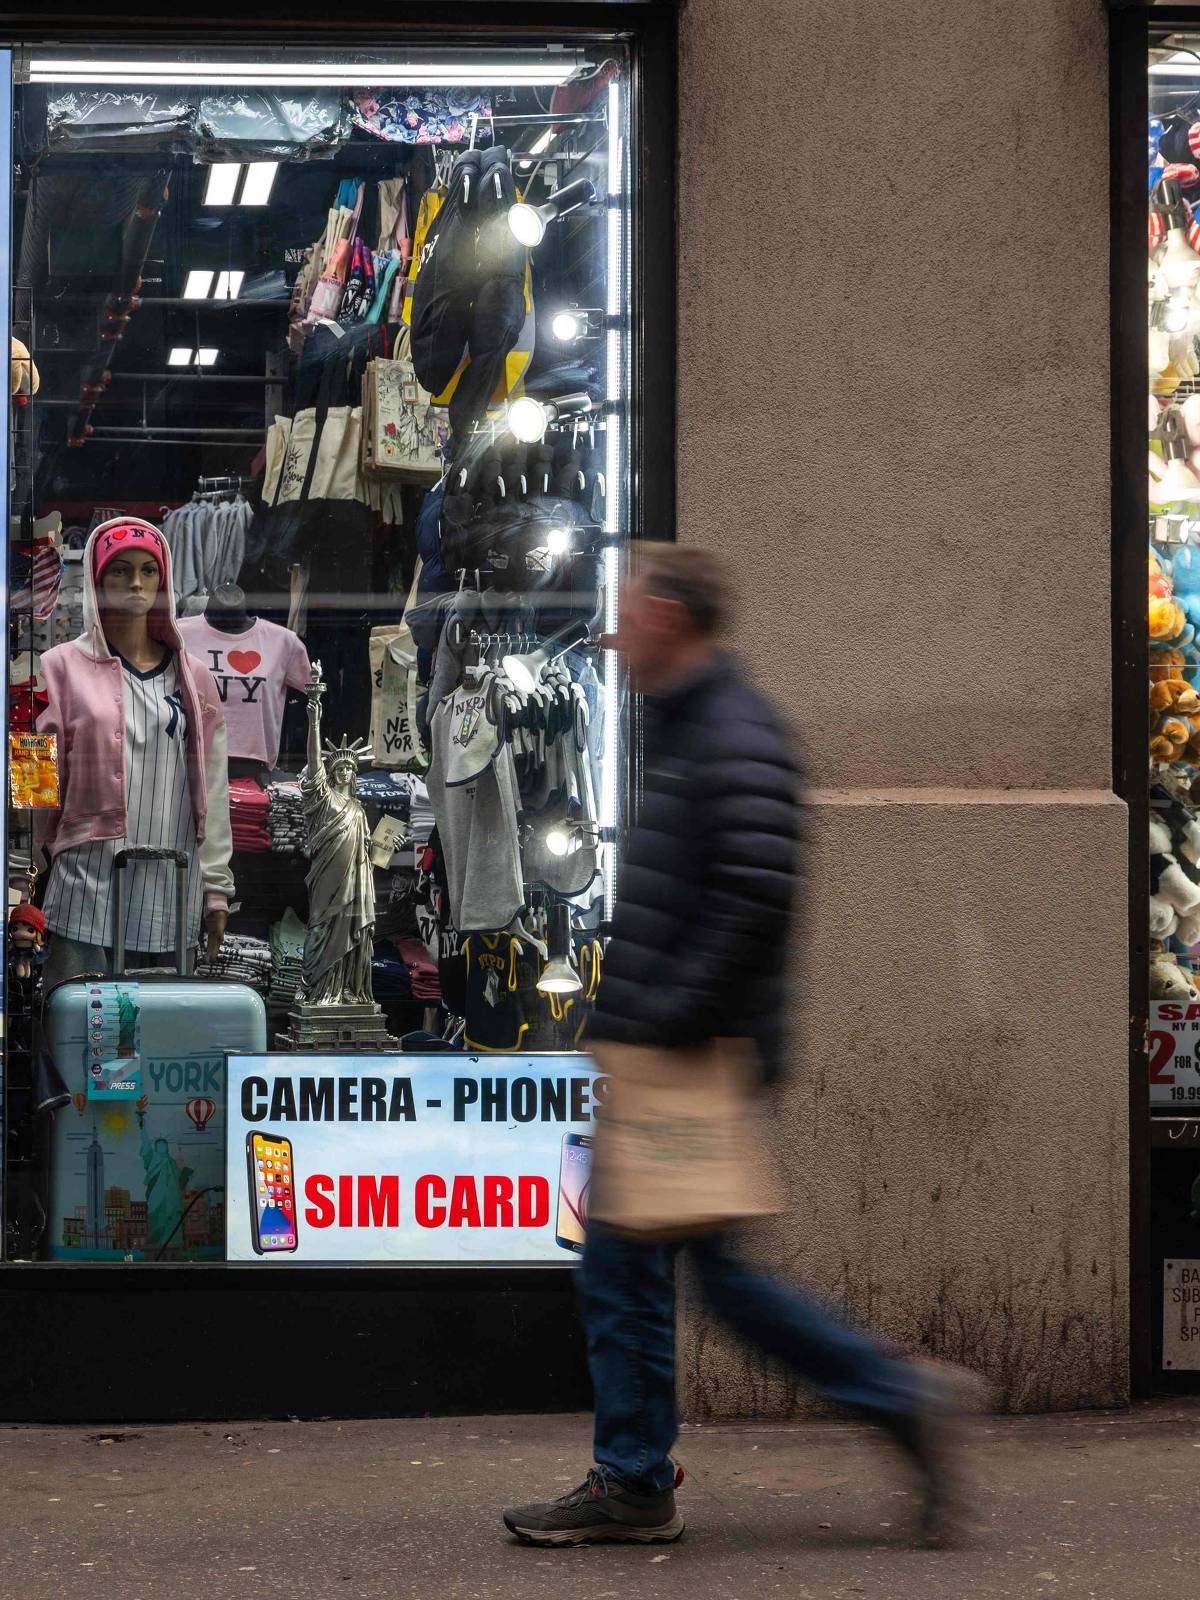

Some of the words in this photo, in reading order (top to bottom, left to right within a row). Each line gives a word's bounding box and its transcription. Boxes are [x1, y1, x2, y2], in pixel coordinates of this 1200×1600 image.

[104, 537, 113, 550] I
[207, 650, 223, 673] I
[386, 716, 411, 735] NE
[383, 733, 413, 754] YOR
[1172, 1022, 1187, 1031] NY
[1149, 1030, 1176, 1085] 2
[1174, 1056, 1192, 1069] FOR
[149, 1061, 221, 1093] YORK
[241, 1076, 417, 1122] CAMERA
[304, 1174, 400, 1229] SIM
[414, 1174, 550, 1229] CARD
